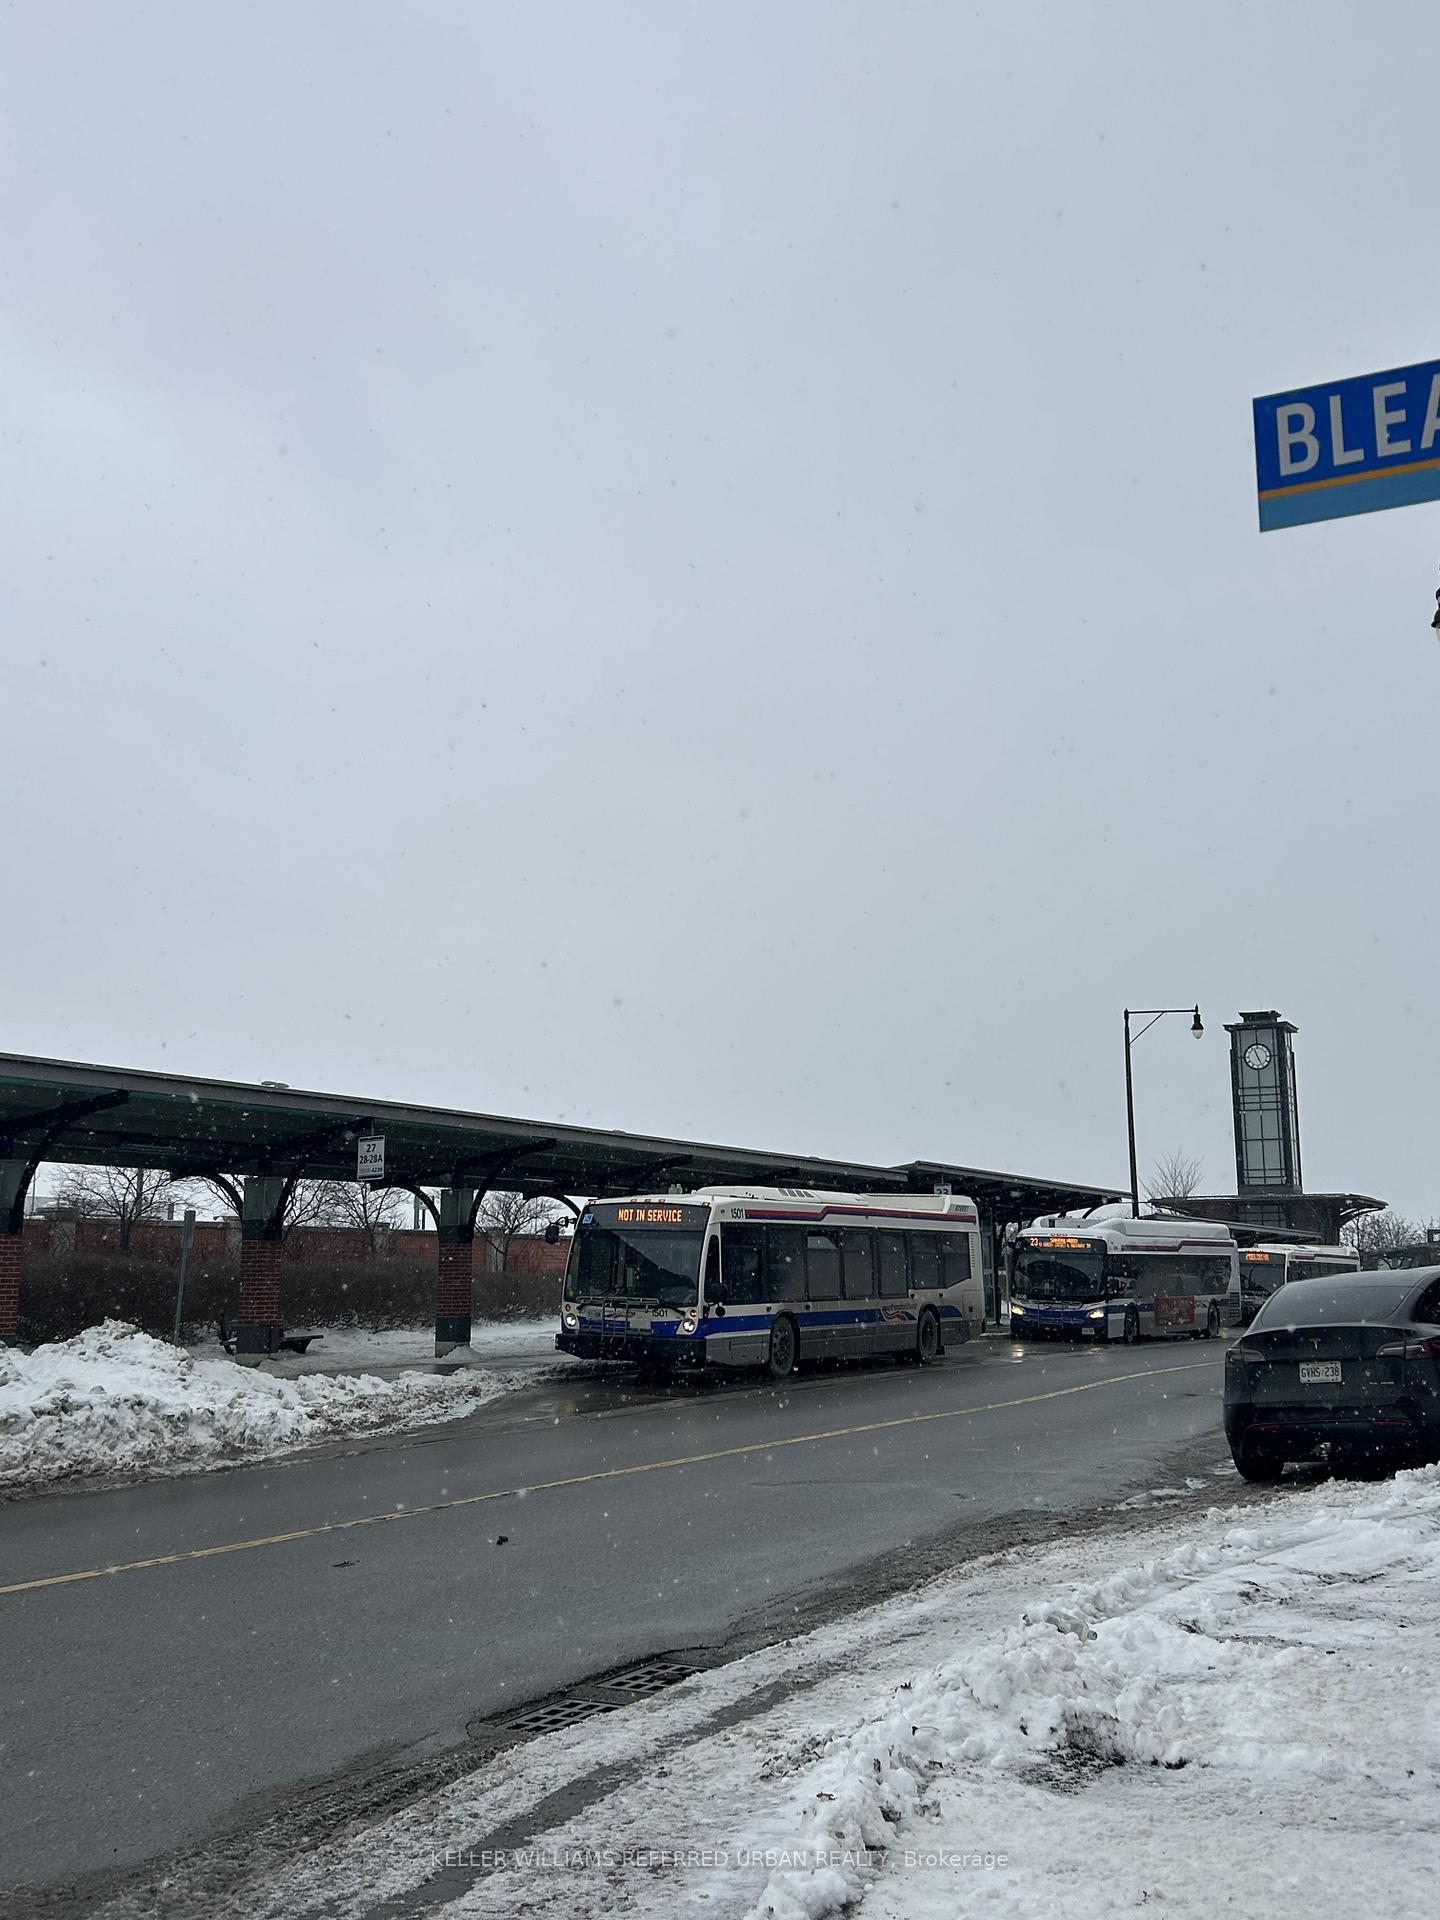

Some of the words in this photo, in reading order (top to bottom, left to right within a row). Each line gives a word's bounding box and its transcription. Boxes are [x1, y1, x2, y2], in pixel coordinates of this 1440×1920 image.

[366, 1144, 376, 1152] 27
[360, 1154, 383, 1164] 28-28A
[618, 1209, 634, 1222] NOT
[635, 1209, 646, 1222] IN
[647, 1209, 683, 1223] SERVICE
[730, 1207, 744, 1219] 1501
[1029, 1237, 1039, 1247] 23
[1324, 1366, 1340, 1378] 238
